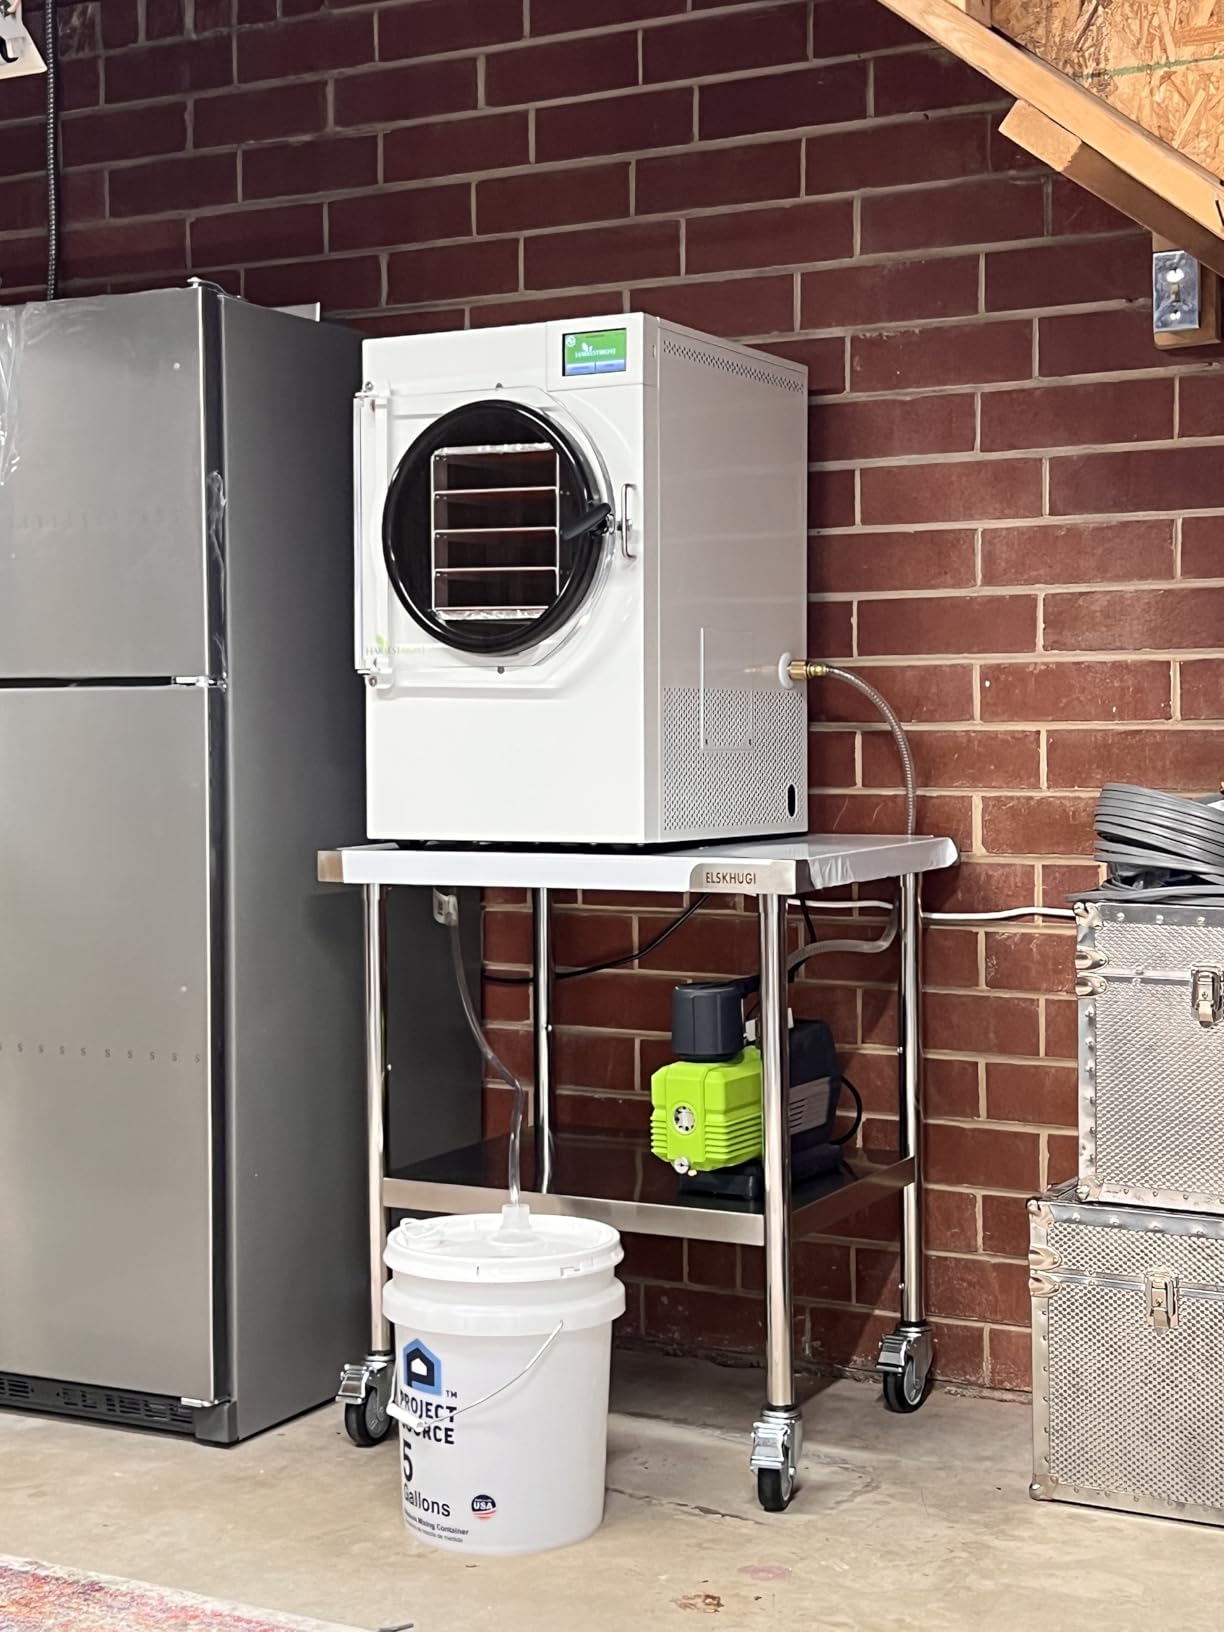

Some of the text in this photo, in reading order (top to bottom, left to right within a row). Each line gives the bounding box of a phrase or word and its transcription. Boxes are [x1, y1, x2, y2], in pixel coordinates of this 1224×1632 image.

[705, 871, 757, 885] ELSKHUGI
[400, 1389, 457, 1423] PROJECT
[402, 1422, 455, 1445] RCE
[403, 1438, 413, 1482] 5
[404, 1483, 451, 1517] Gallons
[473, 1501, 494, 1510] USA
[436, 1523, 470, 1536] Container
